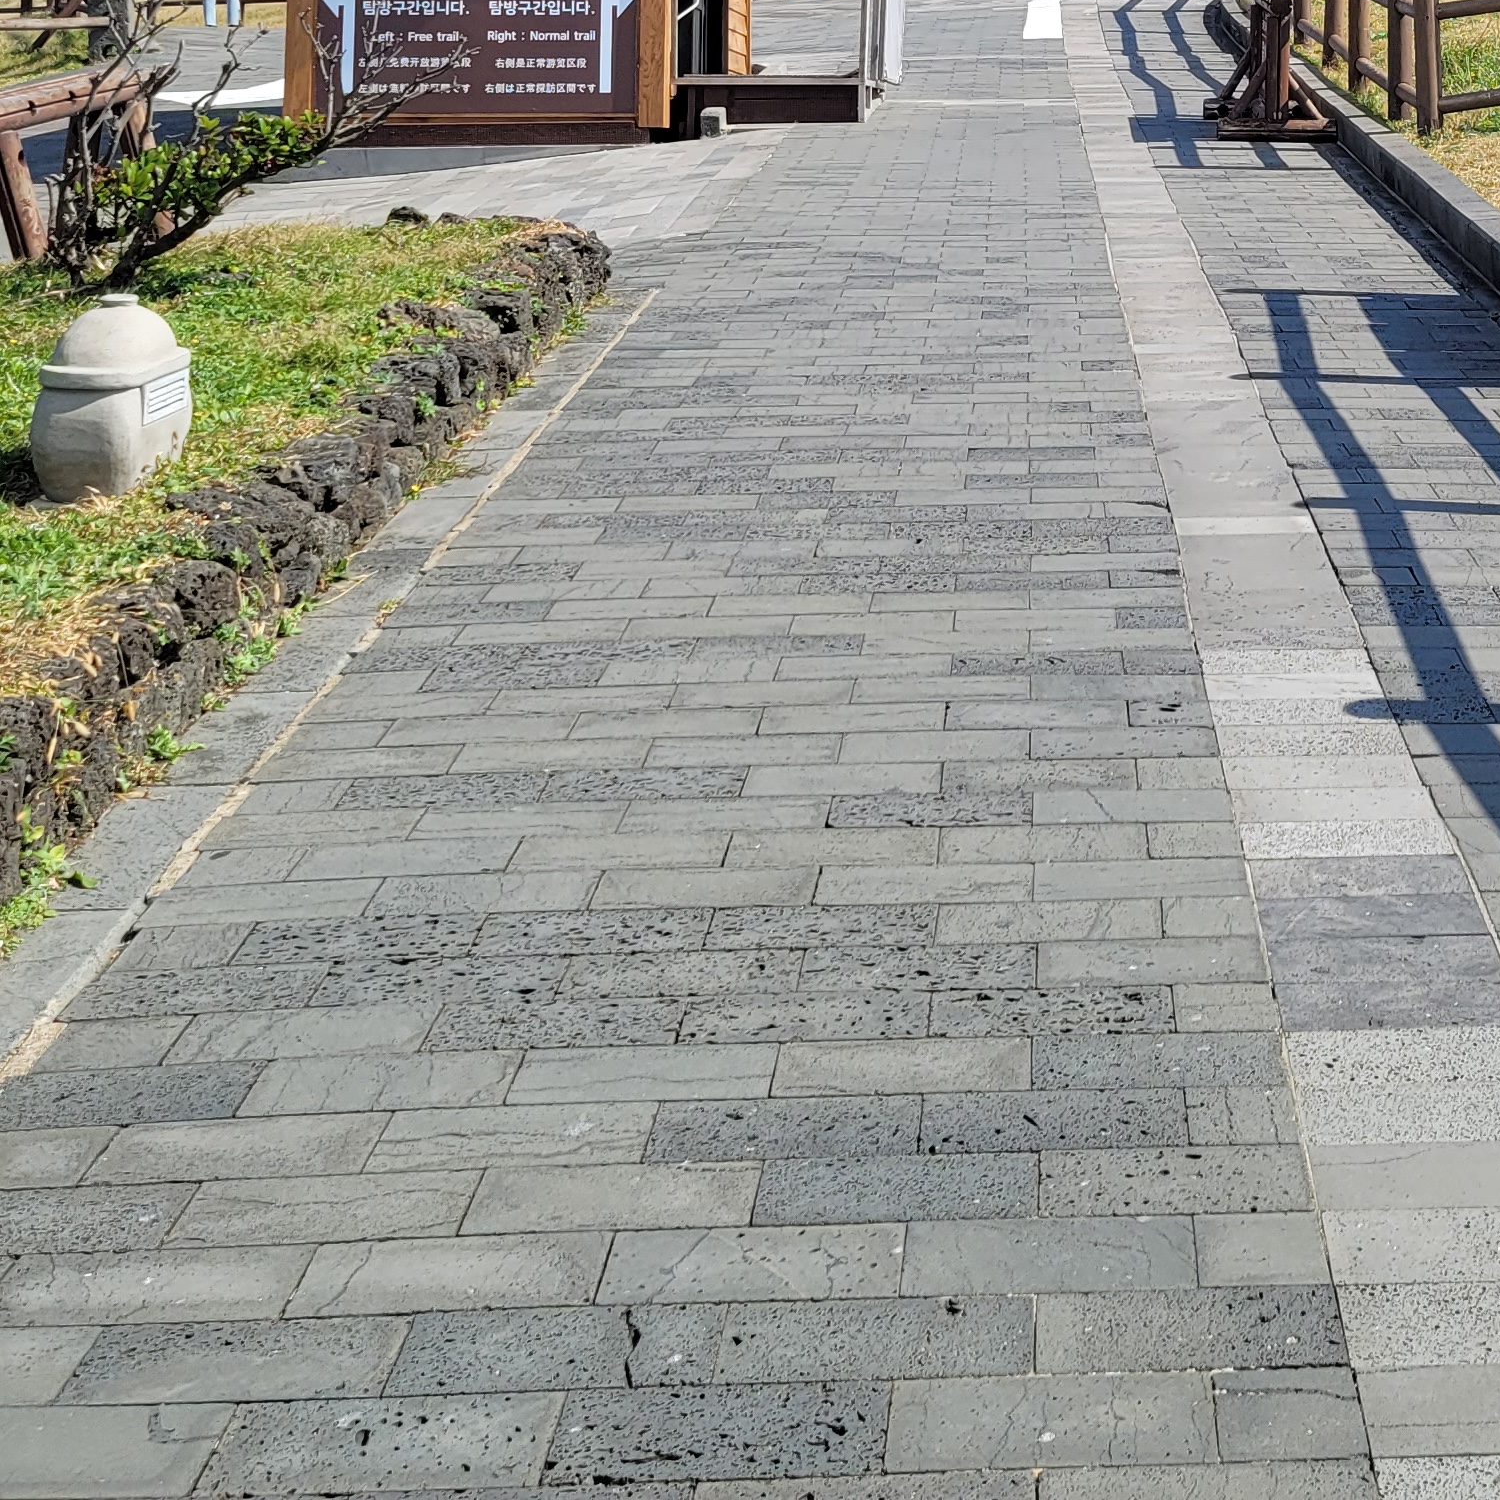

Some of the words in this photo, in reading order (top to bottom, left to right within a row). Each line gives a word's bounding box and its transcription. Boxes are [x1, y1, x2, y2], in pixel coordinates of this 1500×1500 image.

[362, 0, 470, 15] 탐방구간입니다.
[488, 0, 596, 15] 탐방구간입니다.
[408, 31, 433, 41] Free
[437, 31, 460, 41] trail
[487, 30, 516, 43] Right
[529, 30, 569, 41] Normal
[574, 30, 597, 41] trail
